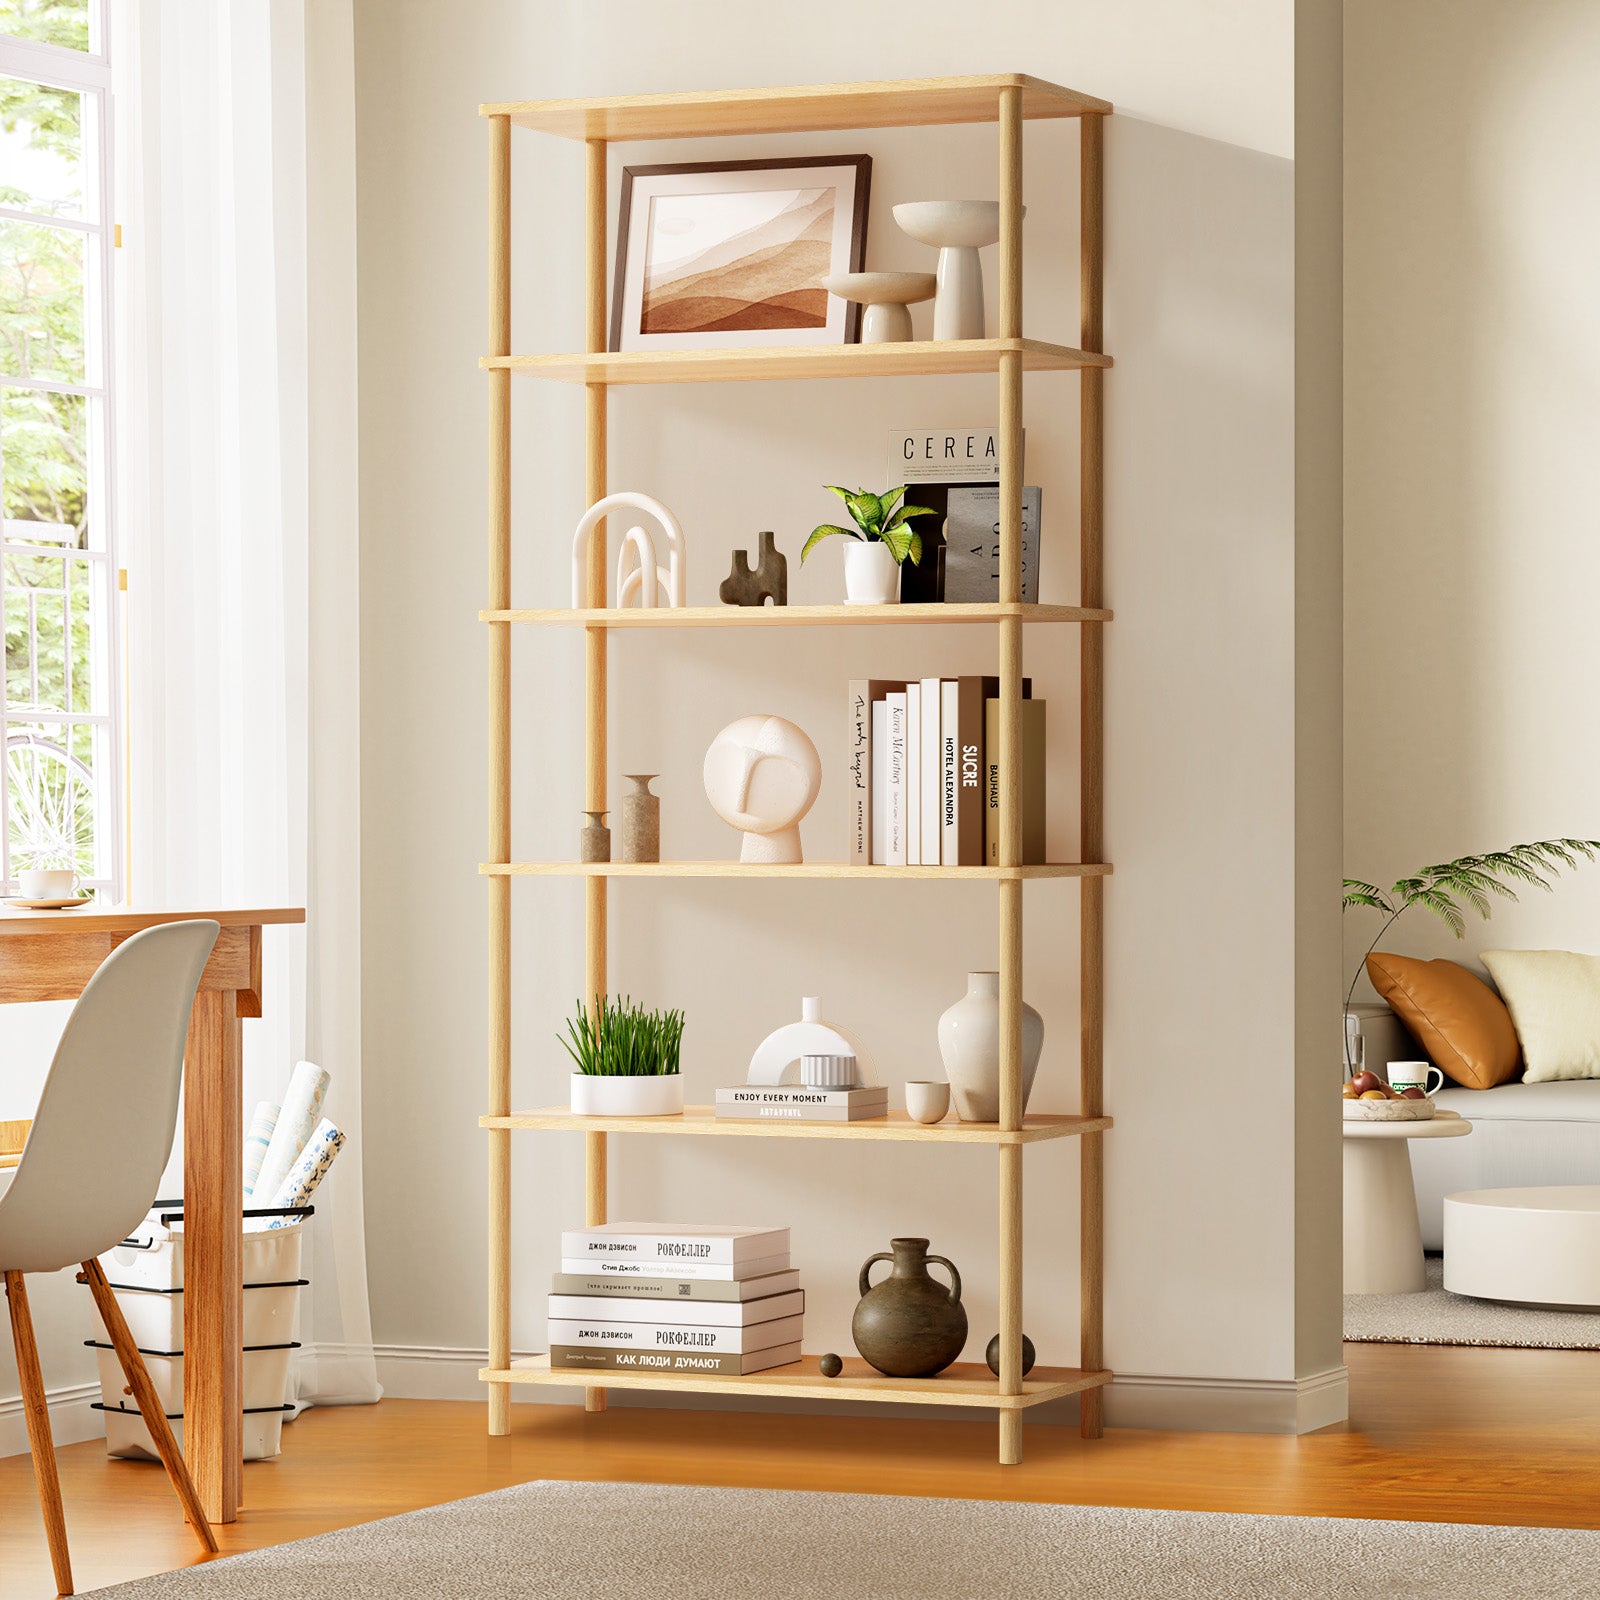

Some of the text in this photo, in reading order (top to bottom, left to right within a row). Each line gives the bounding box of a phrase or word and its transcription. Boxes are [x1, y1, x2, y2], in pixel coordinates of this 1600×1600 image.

[904, 436, 996, 460] CEREA
[893, 707, 903, 734] Karen
[850, 695, 867, 789] The body beyond
[962, 745, 978, 787] SUCRE
[945, 737, 954, 826] HOTEL ALEXANDRA
[989, 764, 998, 808] BAUHAUS
[734, 1093, 828, 1103] ENJOY EVERY MOMENT
[588, 1242, 711, 1258] ДЖОН ДЭВИСОН РОКФЕЛЛЕР
[618, 1264, 640, 1272] Джобс
[578, 1330, 717, 1347] ДЖОН ДЭВИСОН РОКФЕЛЛЕР
[616, 1354, 721, 1369] КАК ЛЮДИ ДУМАЮТ
